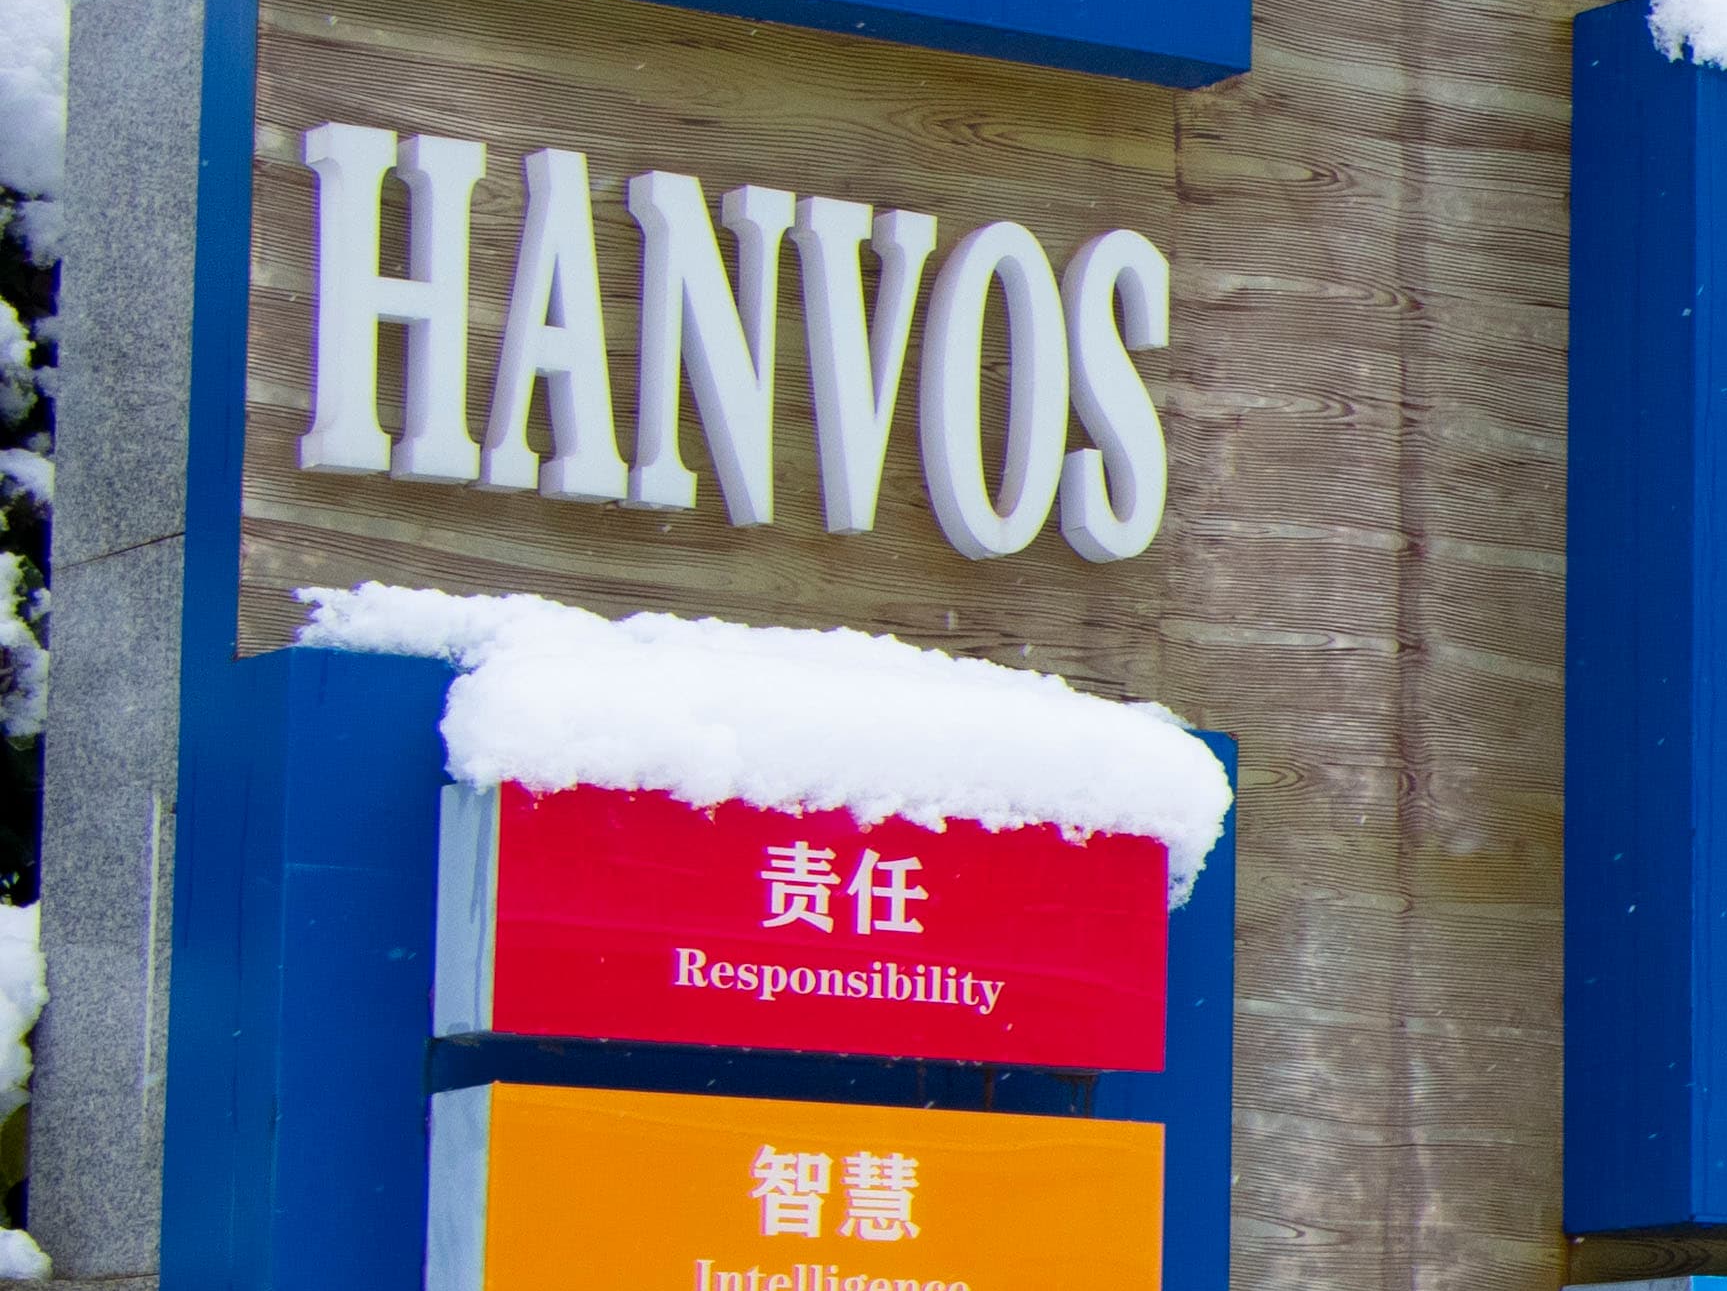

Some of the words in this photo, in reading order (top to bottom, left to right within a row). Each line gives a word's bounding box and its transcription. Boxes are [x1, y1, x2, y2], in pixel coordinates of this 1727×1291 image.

[298, 121, 1170, 564] HANVOS
[760, 840, 930, 936] 责任
[674, 946, 1005, 1015] Responsibility
[750, 1144, 921, 1241] 智慧
